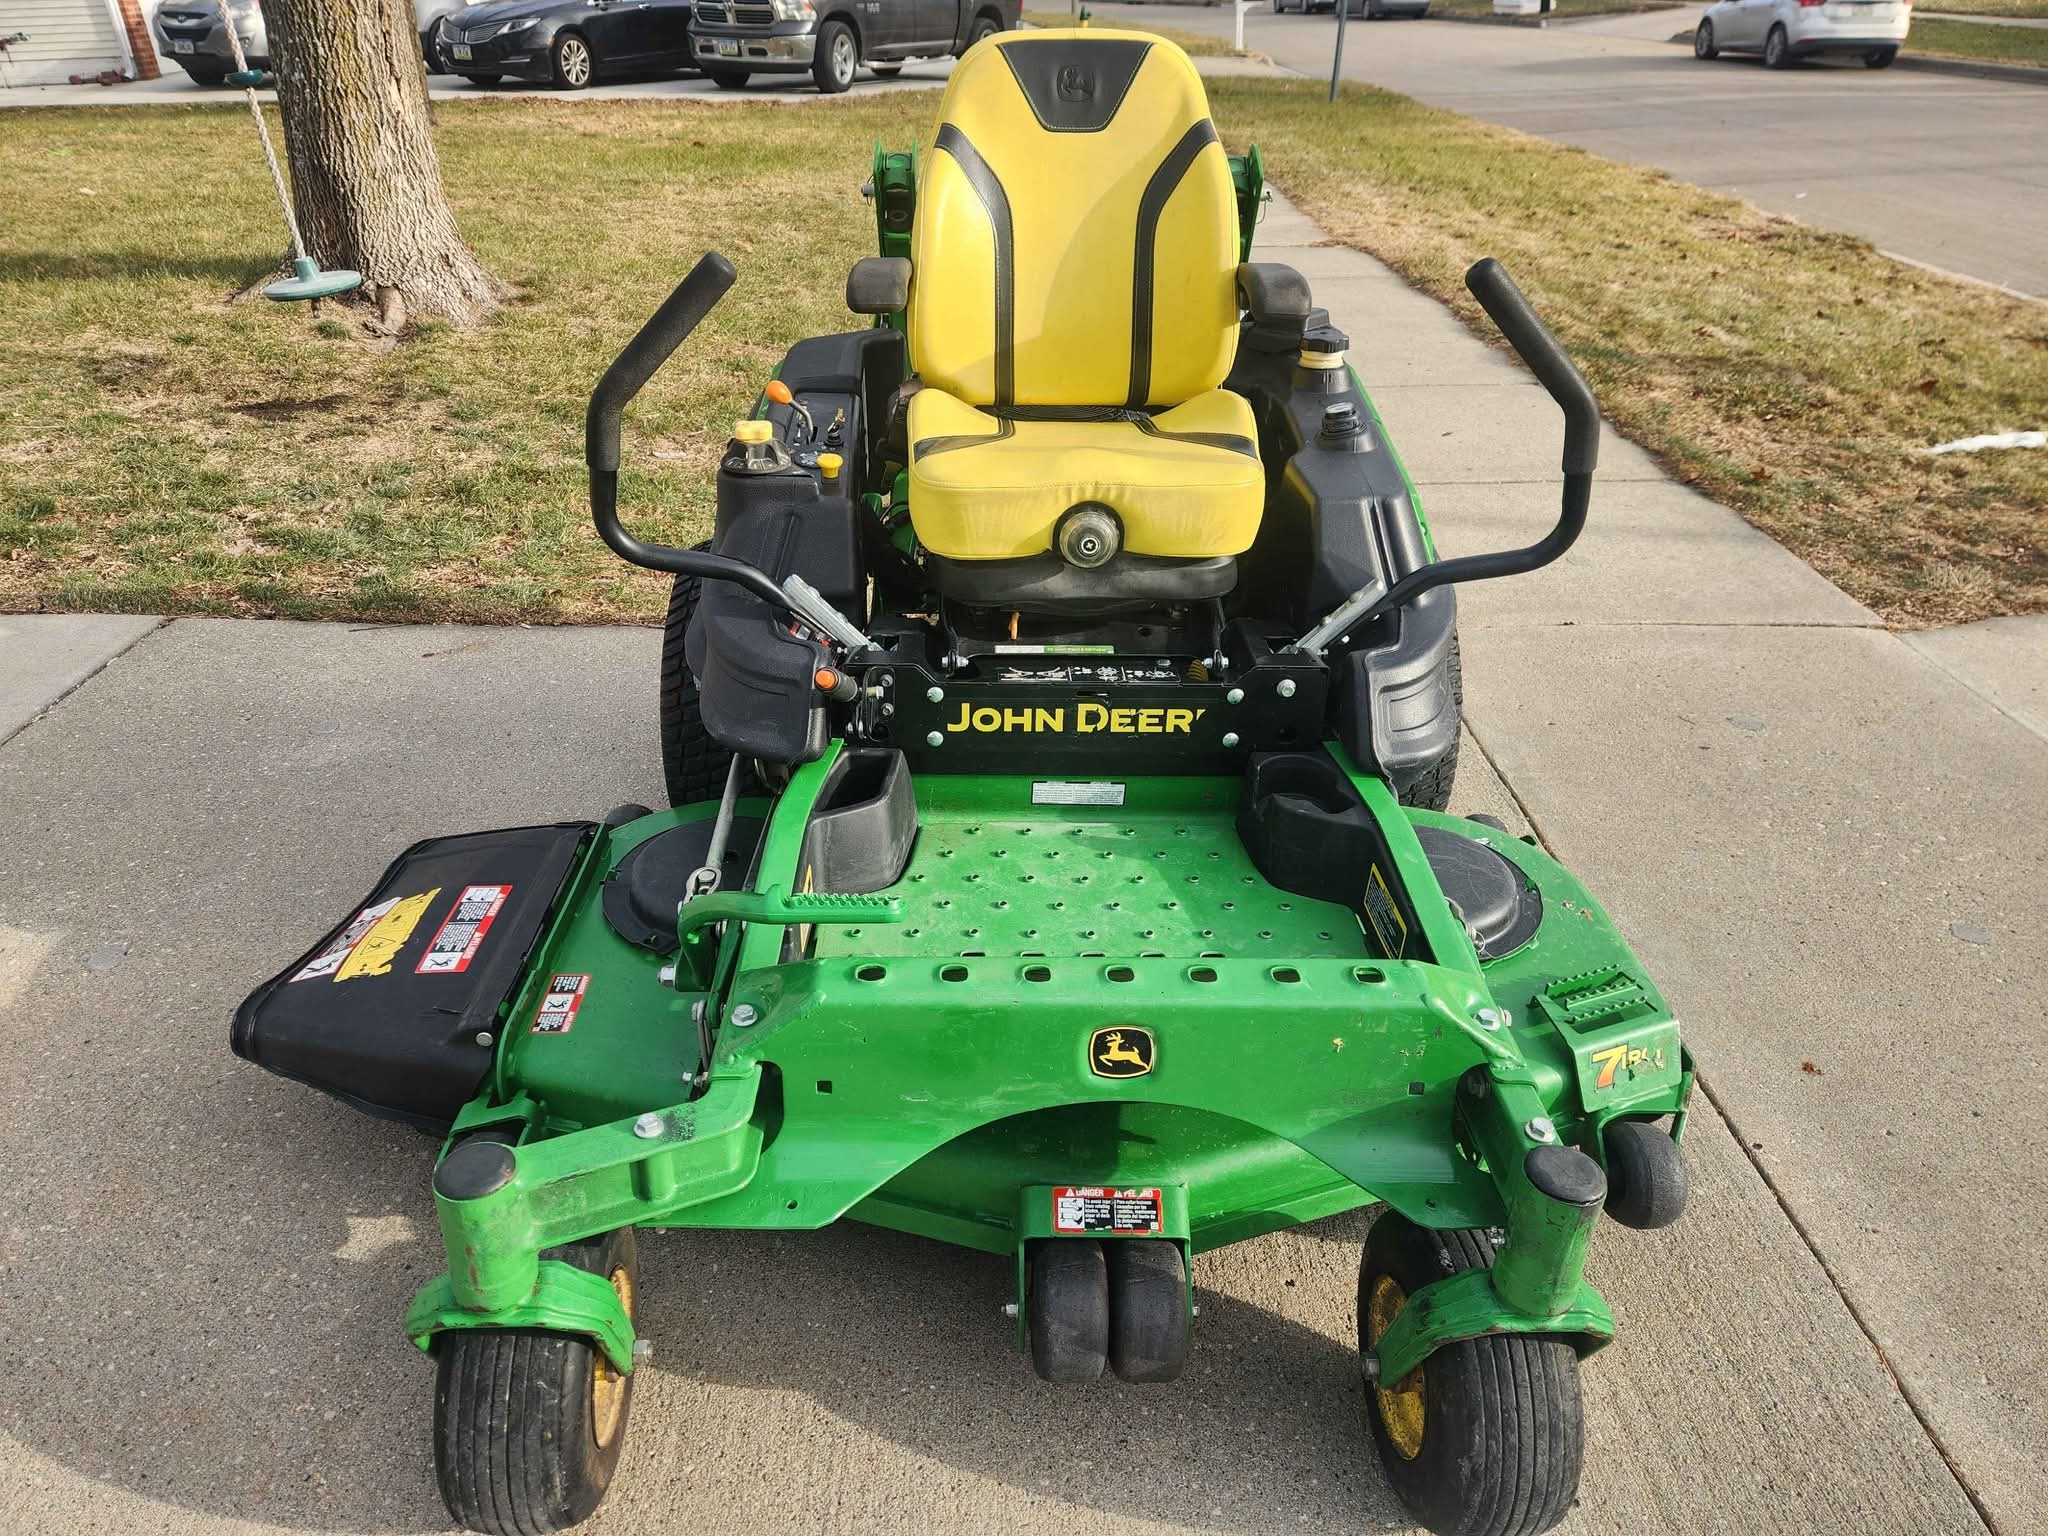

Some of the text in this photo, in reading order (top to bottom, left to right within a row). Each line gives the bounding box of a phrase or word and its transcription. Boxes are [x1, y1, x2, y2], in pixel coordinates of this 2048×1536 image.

[947, 703, 1206, 733] JOHN DEER
[1076, 1188, 1104, 1197] DANGER
